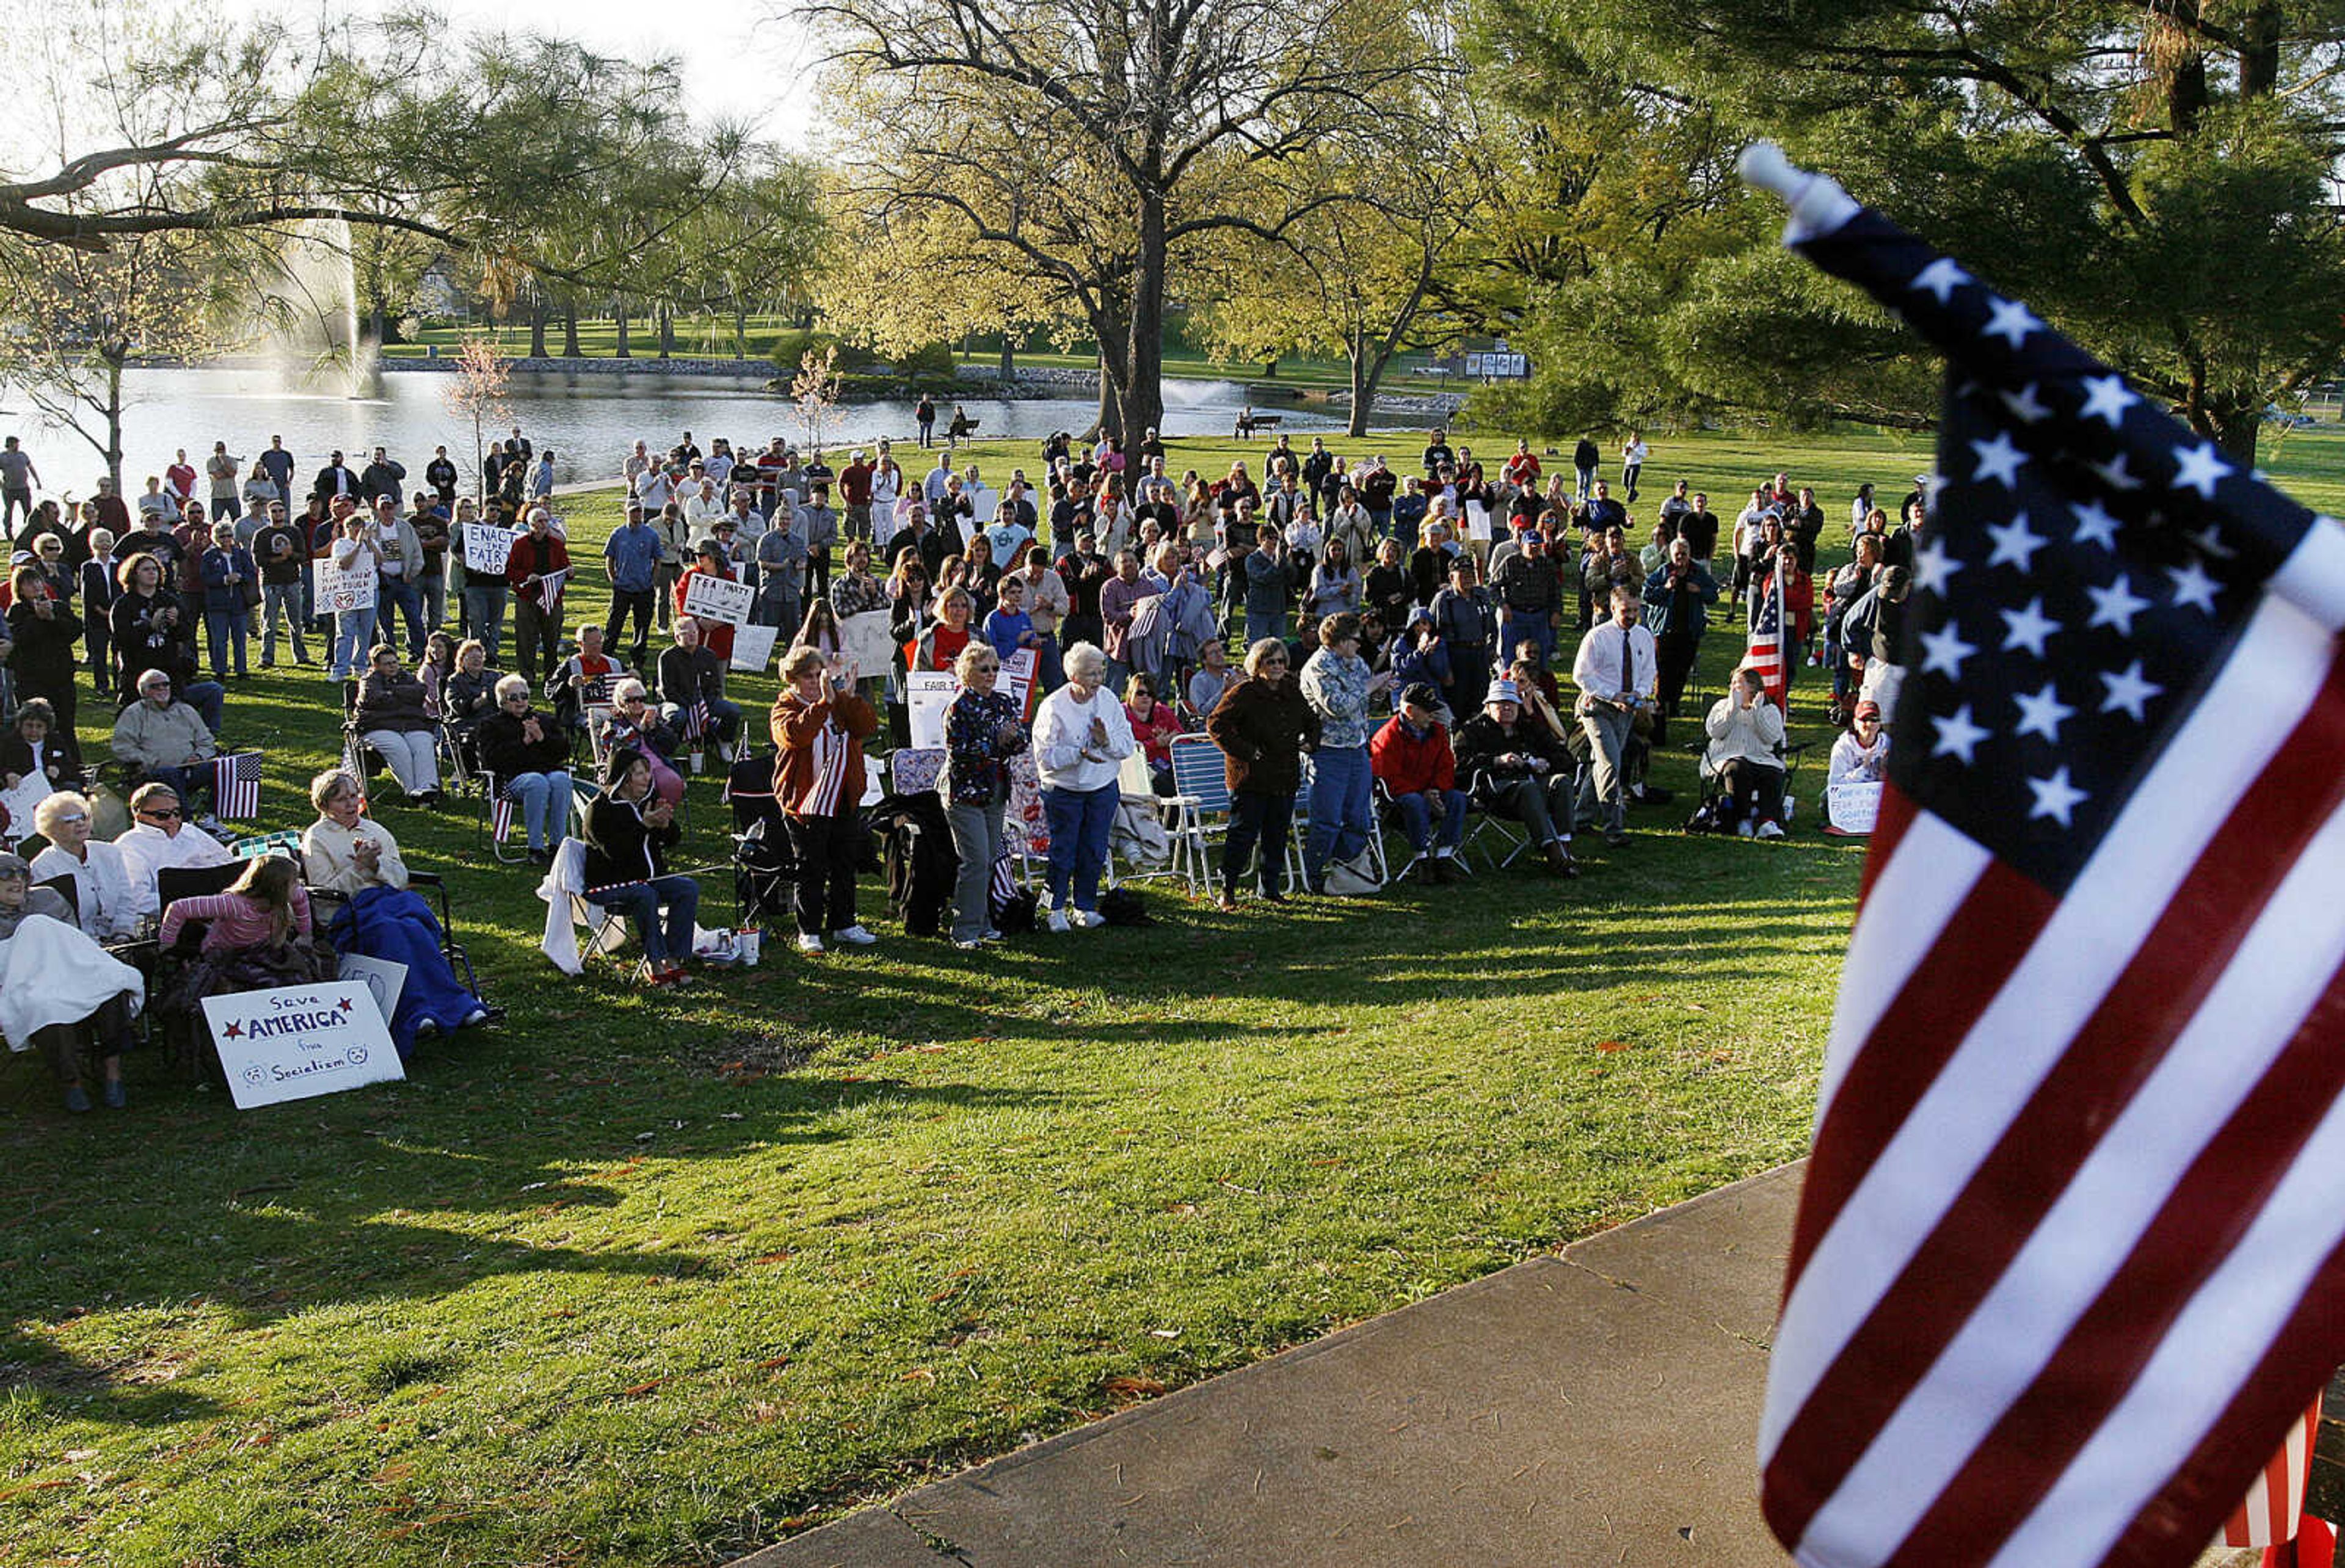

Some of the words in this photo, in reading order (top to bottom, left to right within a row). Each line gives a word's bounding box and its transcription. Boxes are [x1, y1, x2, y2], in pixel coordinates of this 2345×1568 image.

[470, 526, 518, 543] ENACT
[469, 546, 510, 563] FAIRT
[694, 575, 716, 590] TEA
[724, 583, 749, 597] PARTY
[925, 681, 947, 691] FAIR
[270, 996, 321, 1011] Save
[249, 1009, 347, 1039] AMERICA
[271, 1058, 345, 1081] Socialism
